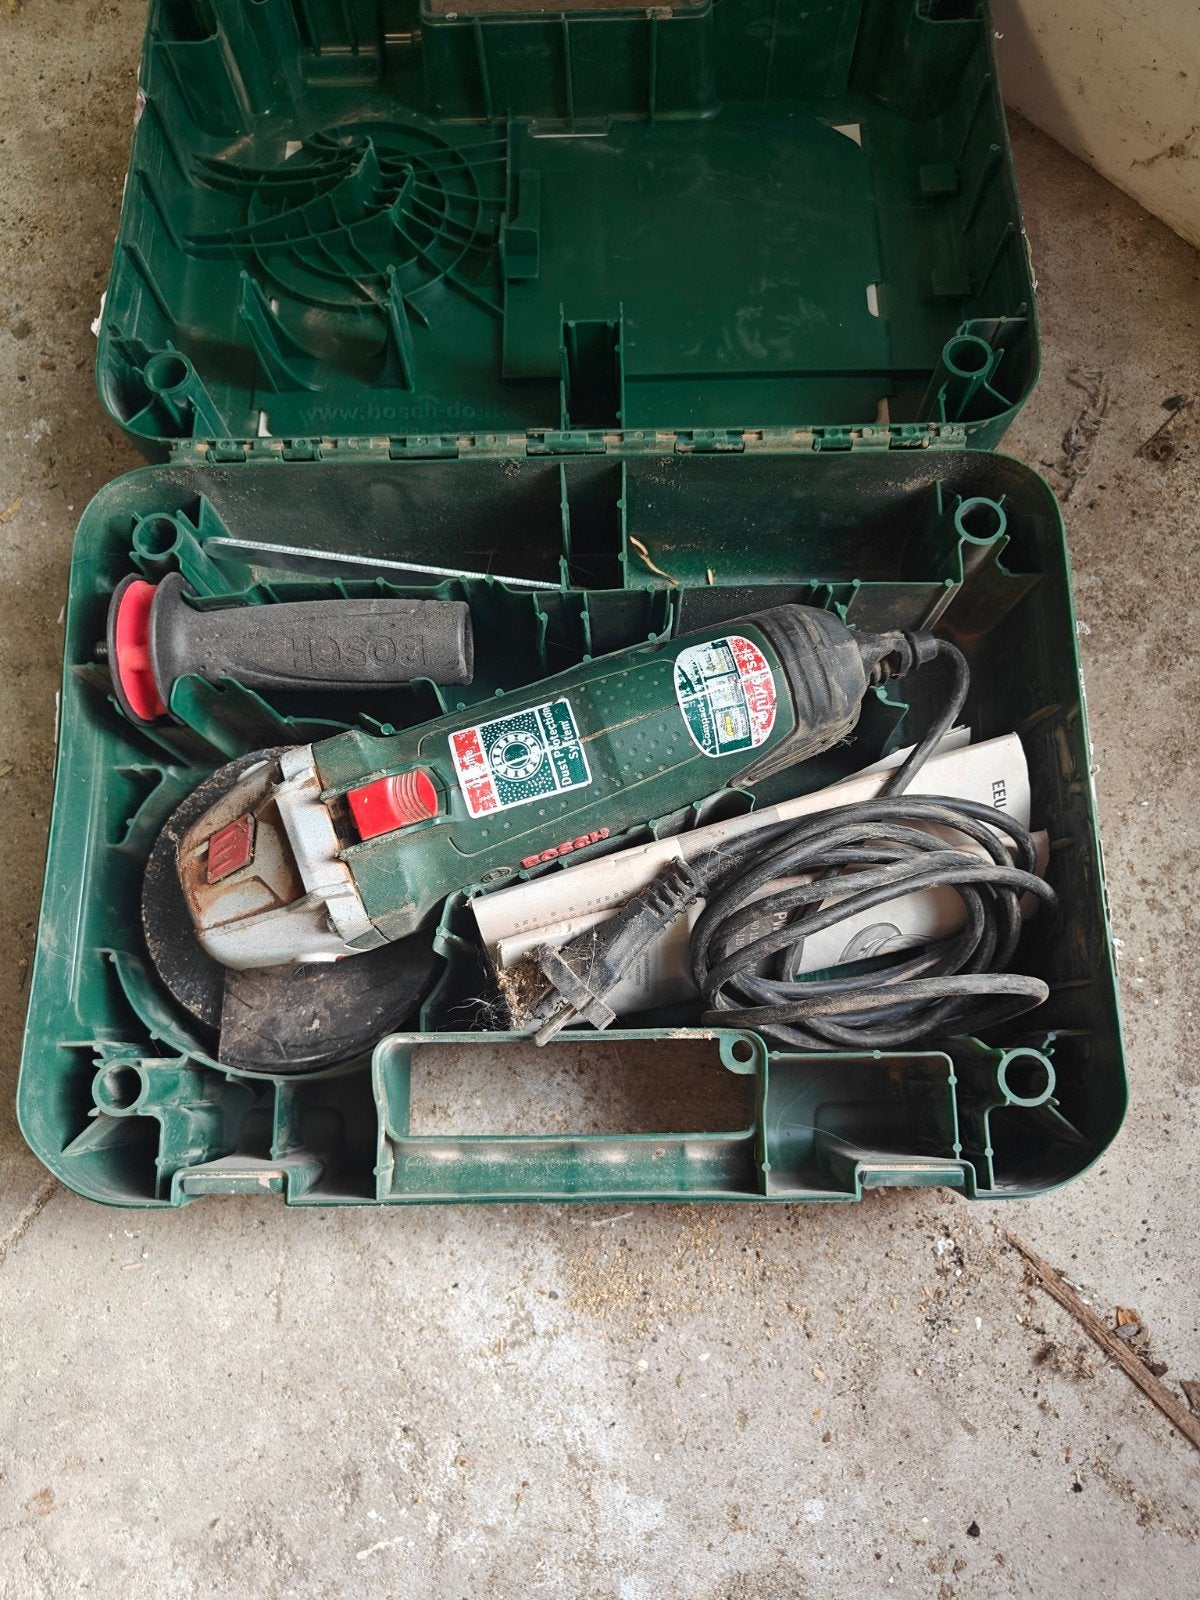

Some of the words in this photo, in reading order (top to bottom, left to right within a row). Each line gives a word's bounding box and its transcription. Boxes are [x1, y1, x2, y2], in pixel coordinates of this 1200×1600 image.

[291, 634, 426, 669] BOSCH
[559, 758, 572, 786] Dust
[992, 780, 1007, 808] EEU
